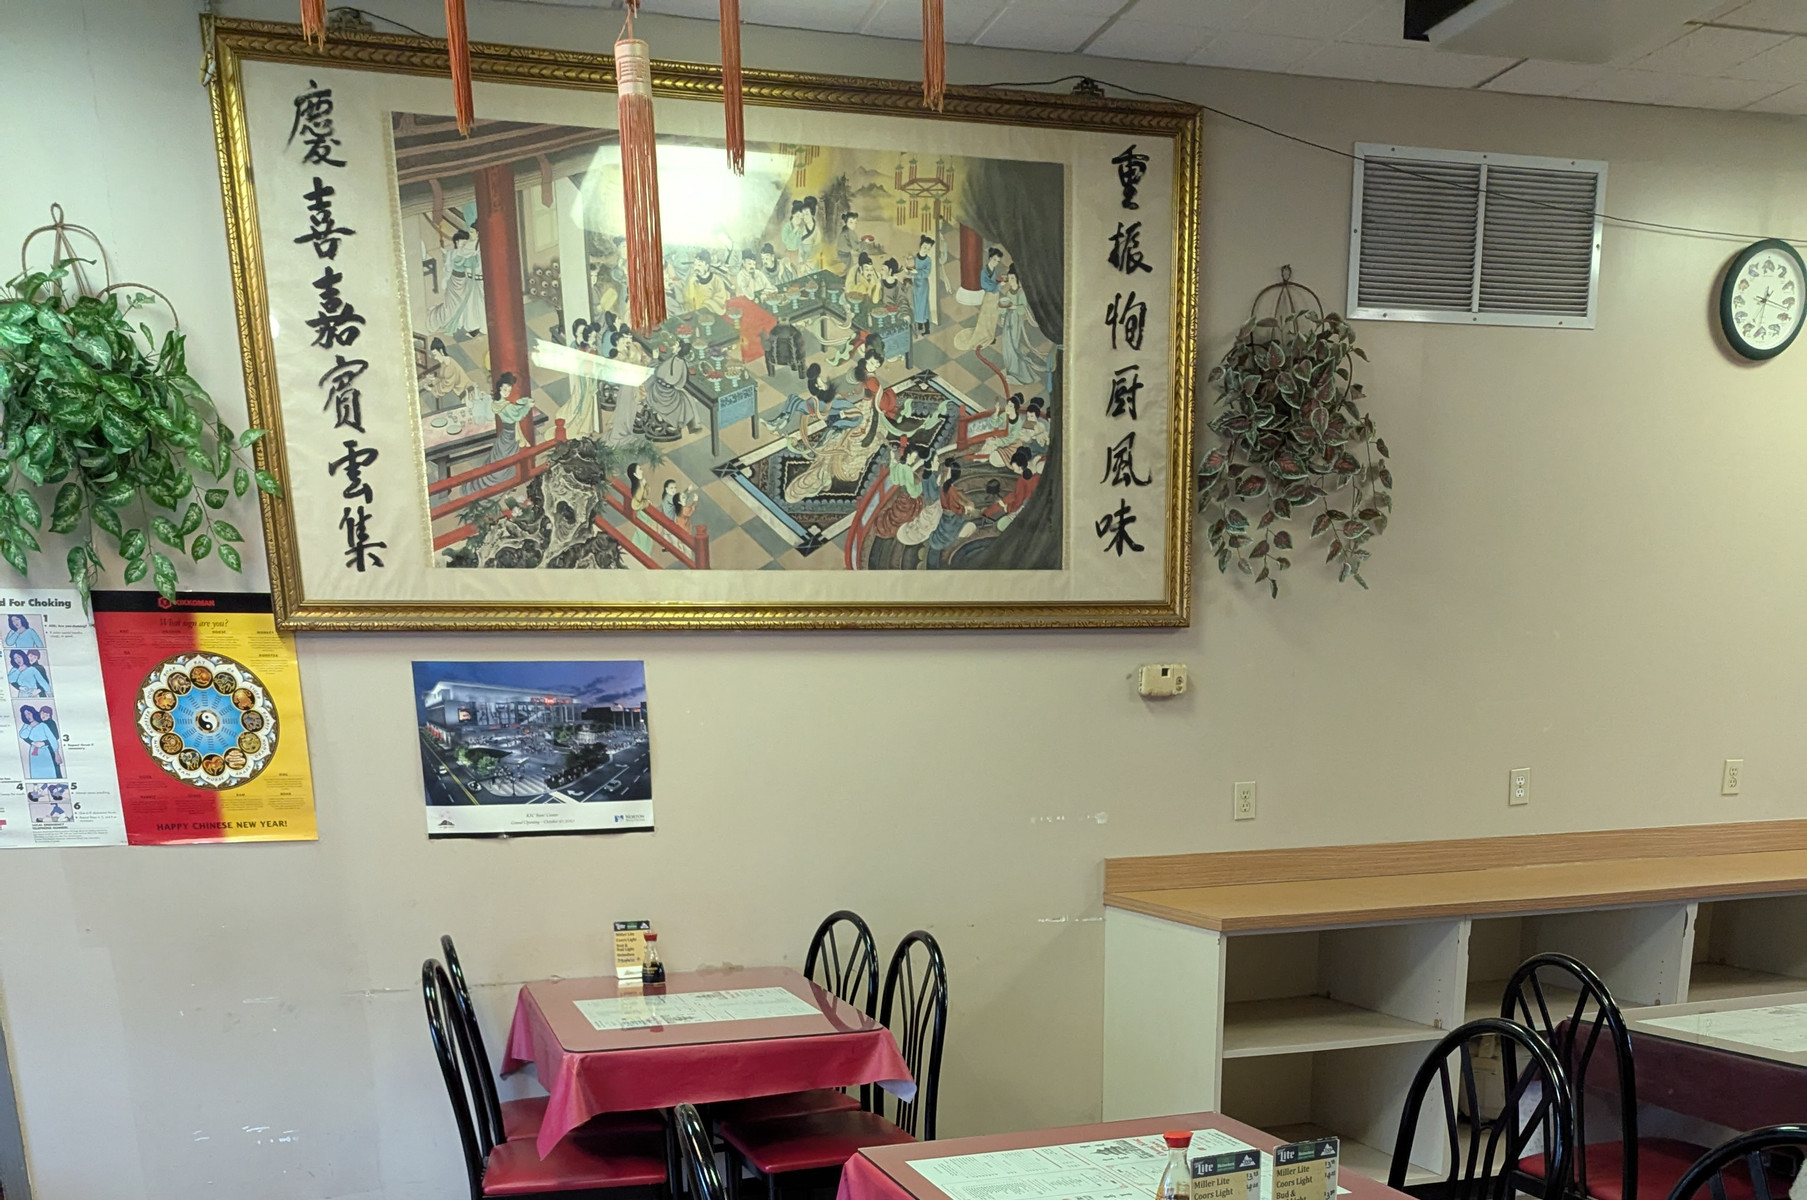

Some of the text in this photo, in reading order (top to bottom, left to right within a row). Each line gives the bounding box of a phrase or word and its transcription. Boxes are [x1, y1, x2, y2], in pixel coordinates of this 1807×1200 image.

[9, 599, 26, 607] For
[28, 598, 71, 609] Choking
[211, 618, 229, 630] you?
[62, 734, 70, 742] 3
[73, 802, 81, 810] 6
[157, 822, 188, 831] HAPPY
[192, 821, 232, 829] CHINESE
[260, 820, 288, 828] YEAR!
[1278, 1150, 1295, 1162] Lite
[1195, 1162, 1214, 1176] Lite
[1277, 1168, 1296, 1177] Miller
[1194, 1179, 1215, 1189] Miller
[1216, 1178, 1230, 1186] Lite
[1276, 1180, 1295, 1188] Coors
[1296, 1176, 1313, 1186] Light
[1194, 1192, 1214, 1200] Coors
[1215, 1188, 1233, 1198] Light
[1276, 1190, 1289, 1200] Bud
